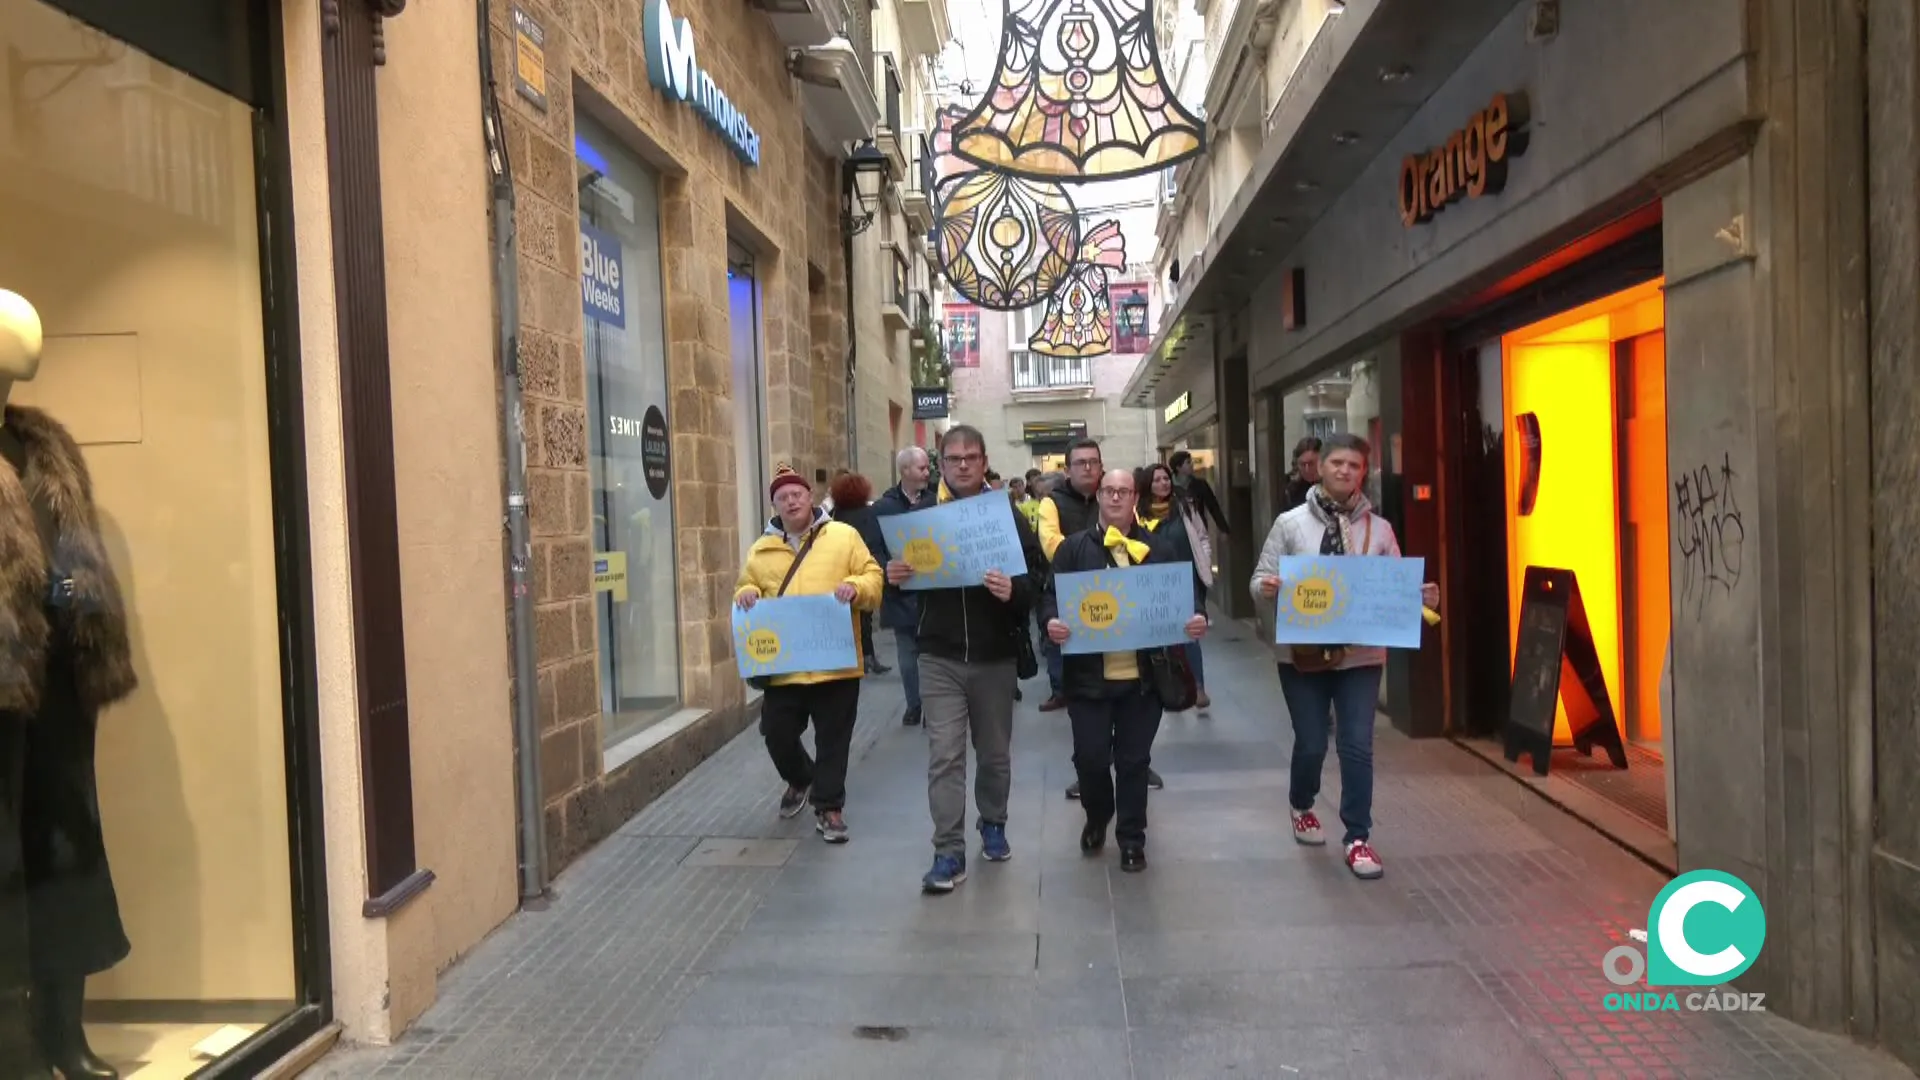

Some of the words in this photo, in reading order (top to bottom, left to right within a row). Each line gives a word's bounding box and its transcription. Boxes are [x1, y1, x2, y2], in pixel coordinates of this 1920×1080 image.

[702, 69, 761, 168] movistar
[1398, 91, 1508, 229] Orange
[580, 232, 619, 289] Blue
[582, 276, 621, 316] Weeks
[917, 396, 943, 407] LOWI
